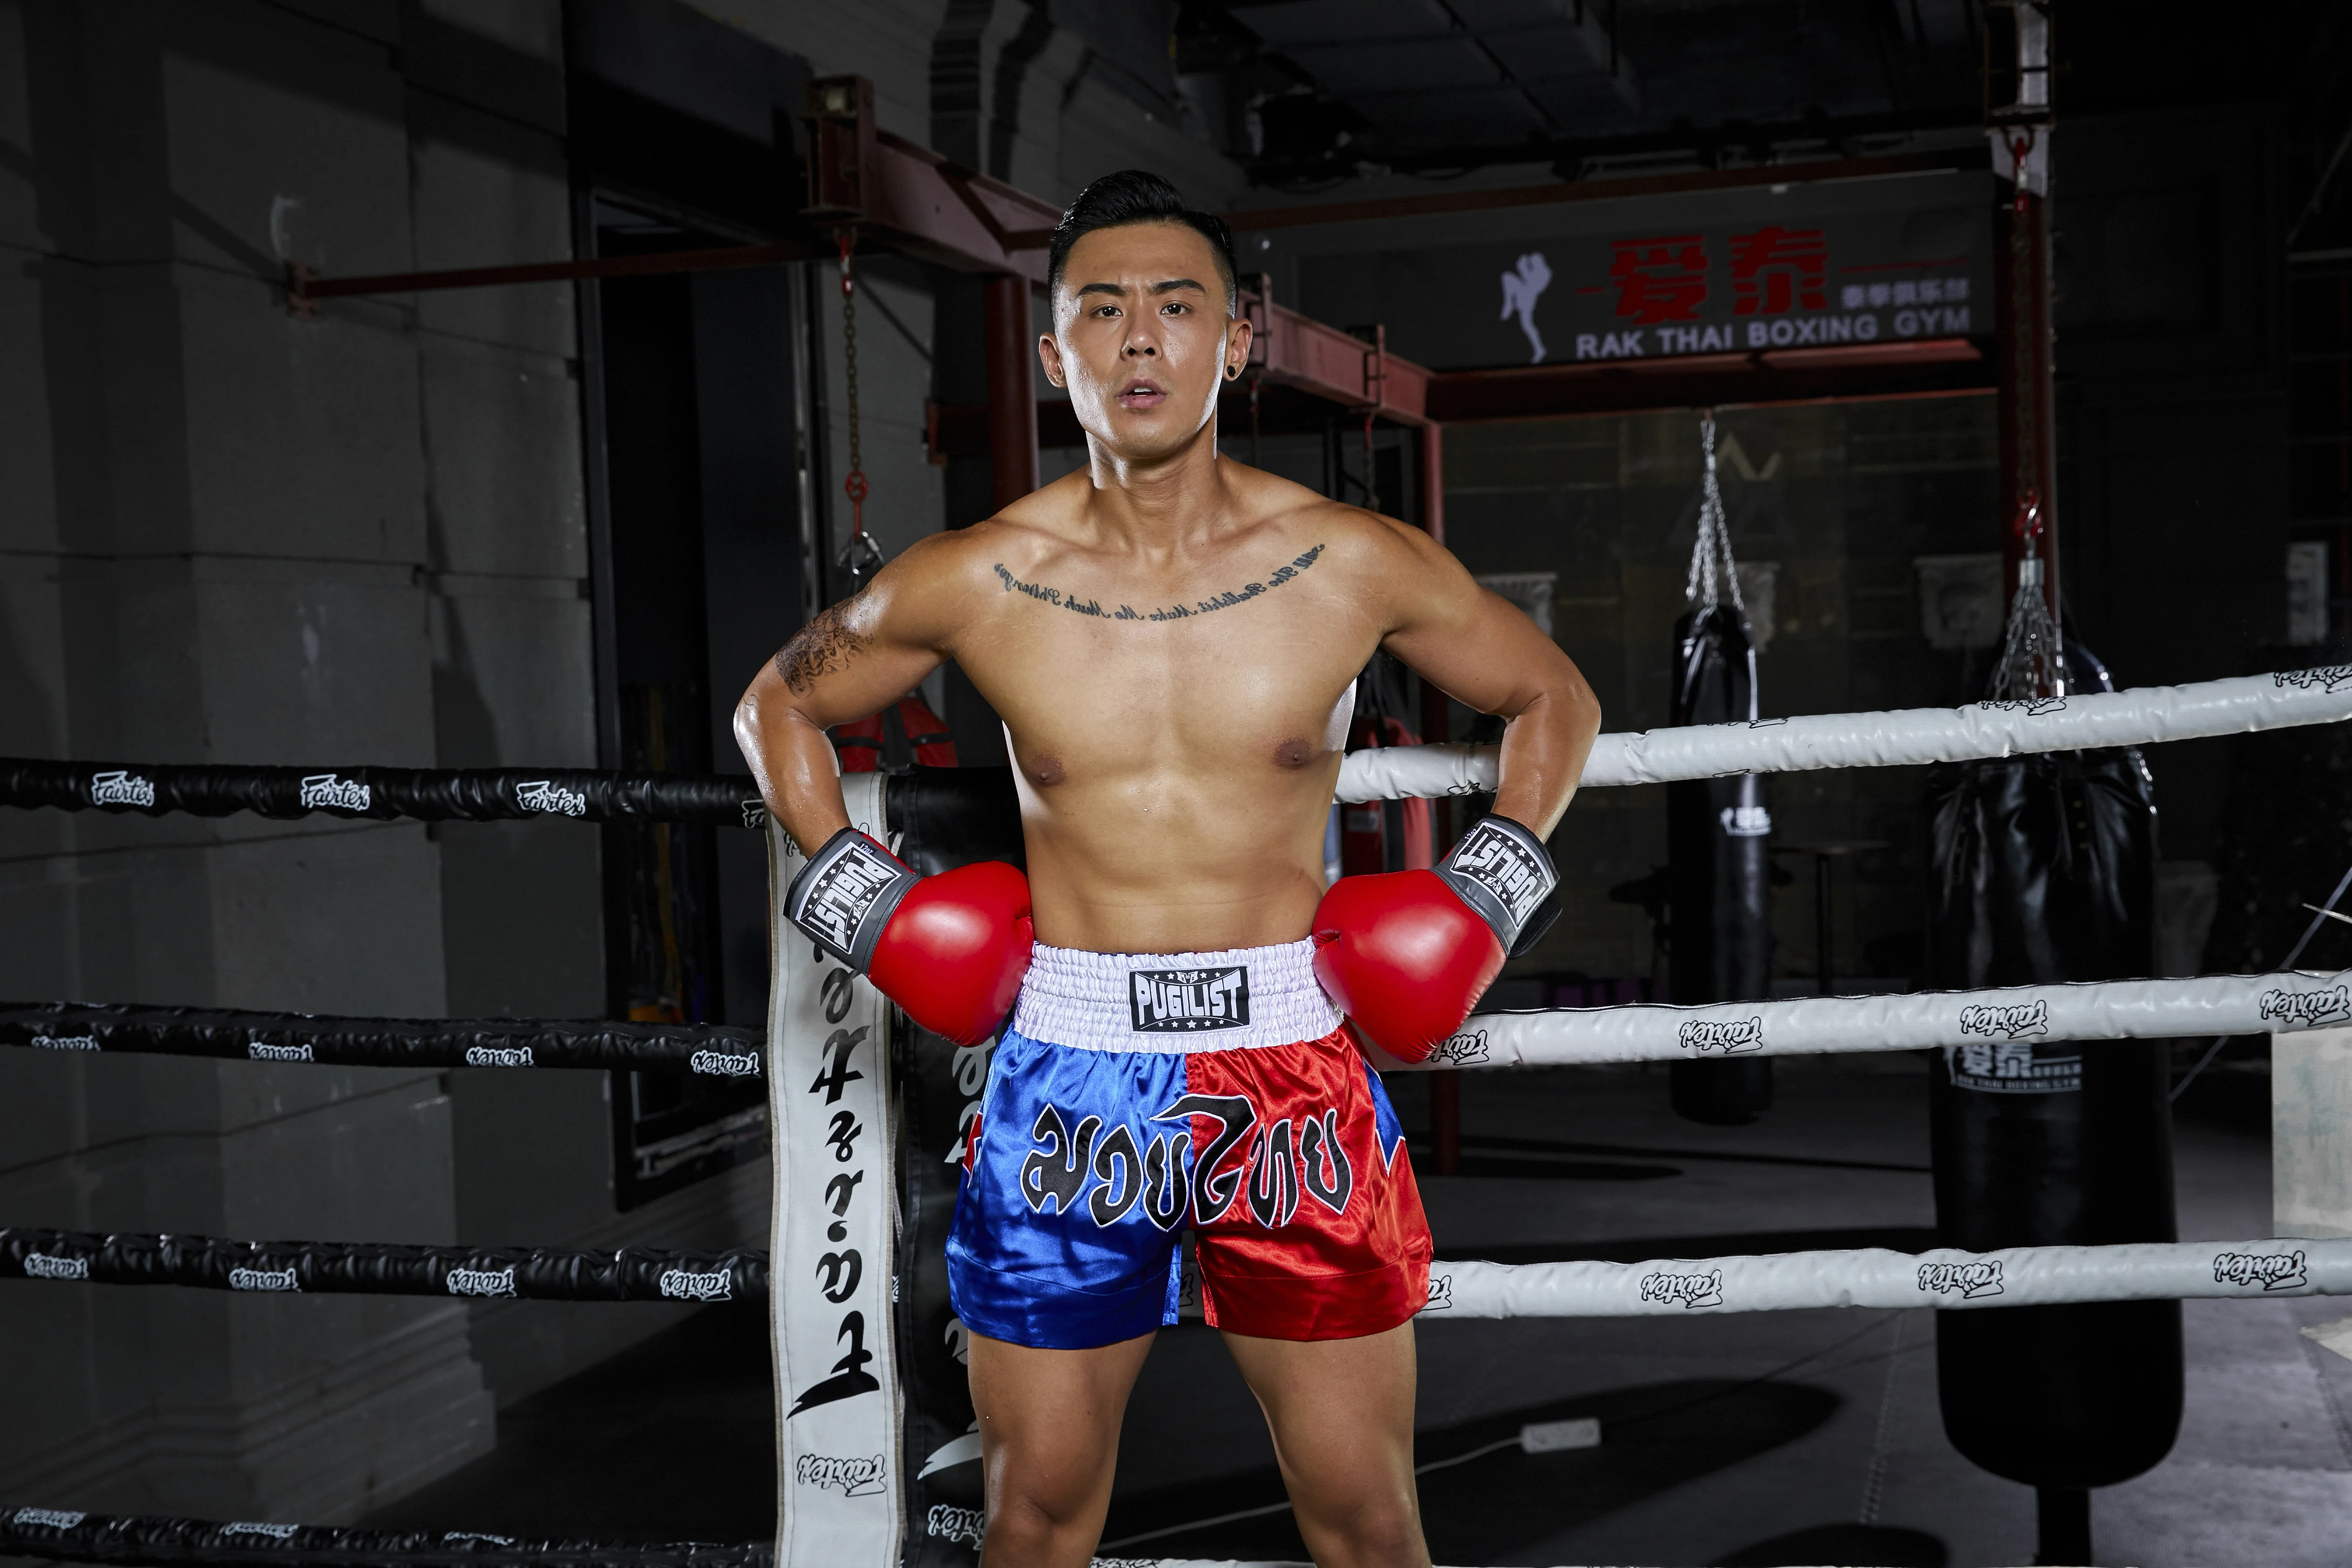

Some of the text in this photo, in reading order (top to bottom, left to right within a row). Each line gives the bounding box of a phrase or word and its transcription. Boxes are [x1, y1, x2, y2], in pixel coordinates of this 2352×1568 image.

[1575, 305, 1970, 359] RAK THAI BOXING GYM
[301, 774, 370, 811] Fairtex
[516, 780, 586, 816] Fairtex
[1455, 833, 1546, 926] PUGILIST
[808, 850, 896, 950] PUGILIST
[1136, 973, 1242, 1026] PUGILIST
[1961, 1000, 2048, 1039] Fairtex
[2261, 985, 2351, 1027] Fairtex
[1431, 1029, 1490, 1065] Fairt
[1680, 1016, 1763, 1054] Fairtex
[690, 1050, 762, 1079] Fairtex
[786, 944, 880, 1420] Fairte
[659, 1268, 733, 1302] Fairtex
[1641, 1270, 1723, 1309] Fairtex
[1918, 1260, 2004, 1300] Fairtex
[2214, 1250, 2307, 1291] Fairtex
[798, 1454, 887, 1498] Fairtex
